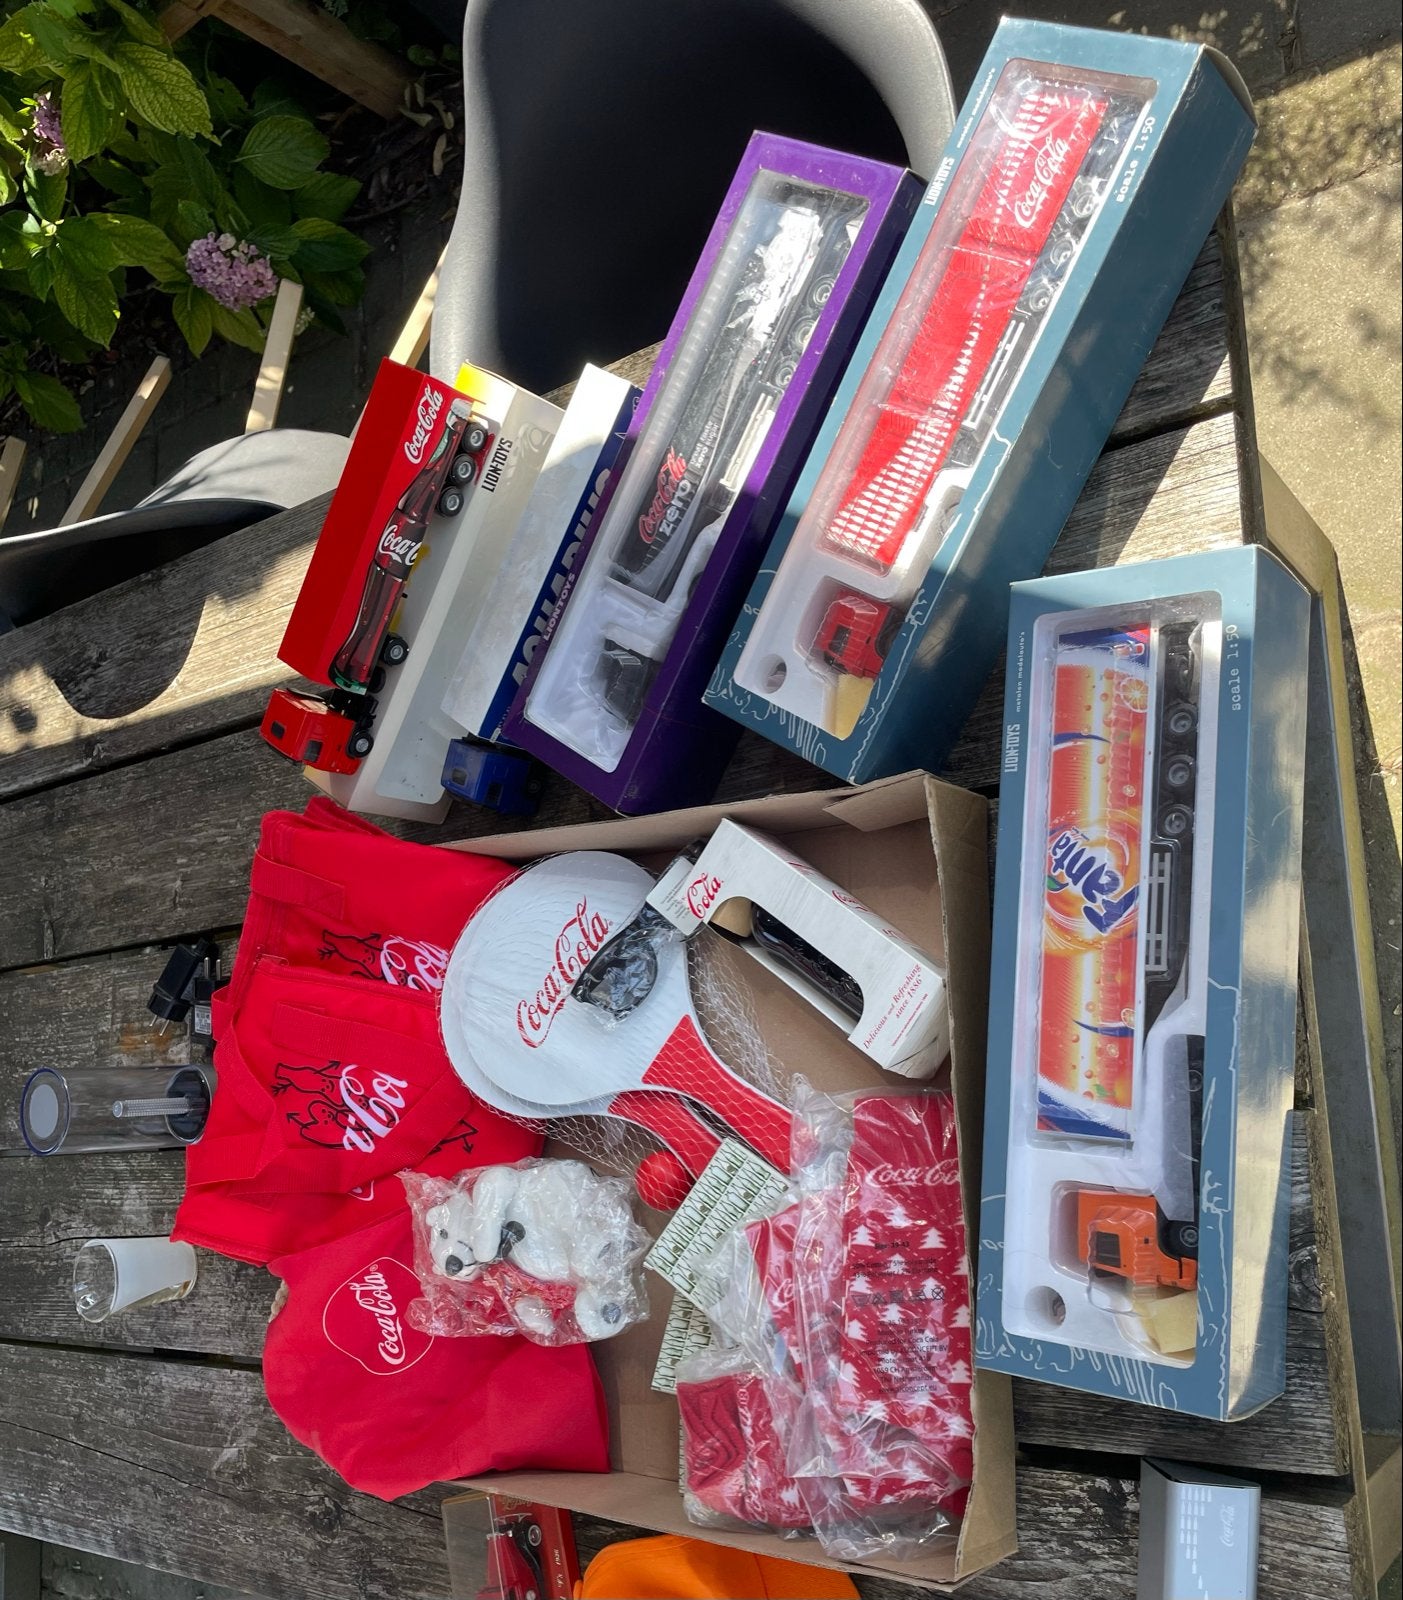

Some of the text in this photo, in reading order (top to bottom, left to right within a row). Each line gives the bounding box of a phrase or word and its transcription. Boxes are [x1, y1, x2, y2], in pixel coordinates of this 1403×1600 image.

[1013, 137, 1070, 228] Coca-Cola
[1116, 116, 1156, 202] scale 1:50
[404, 384, 443, 464] Coca-Cola
[481, 438, 513, 493] LION-TOYS
[659, 480, 691, 536] zero
[542, 572, 575, 641] LIONTOYS
[1015, 631, 1026, 713] metalen modelauto's
[1225, 624, 1241, 711] scale 1:50
[1004, 723, 1021, 773] LION-TOYS
[686, 873, 722, 919] Cola
[1052, 830, 1139, 935] Fanta
[517, 895, 609, 1048] Coca-Cola
[863, 1015, 888, 1049] Delicious
[892, 964, 921, 1003] Refreshing
[895, 1000, 909, 1018] since
[348, 1270, 405, 1365] Coca-Cola
